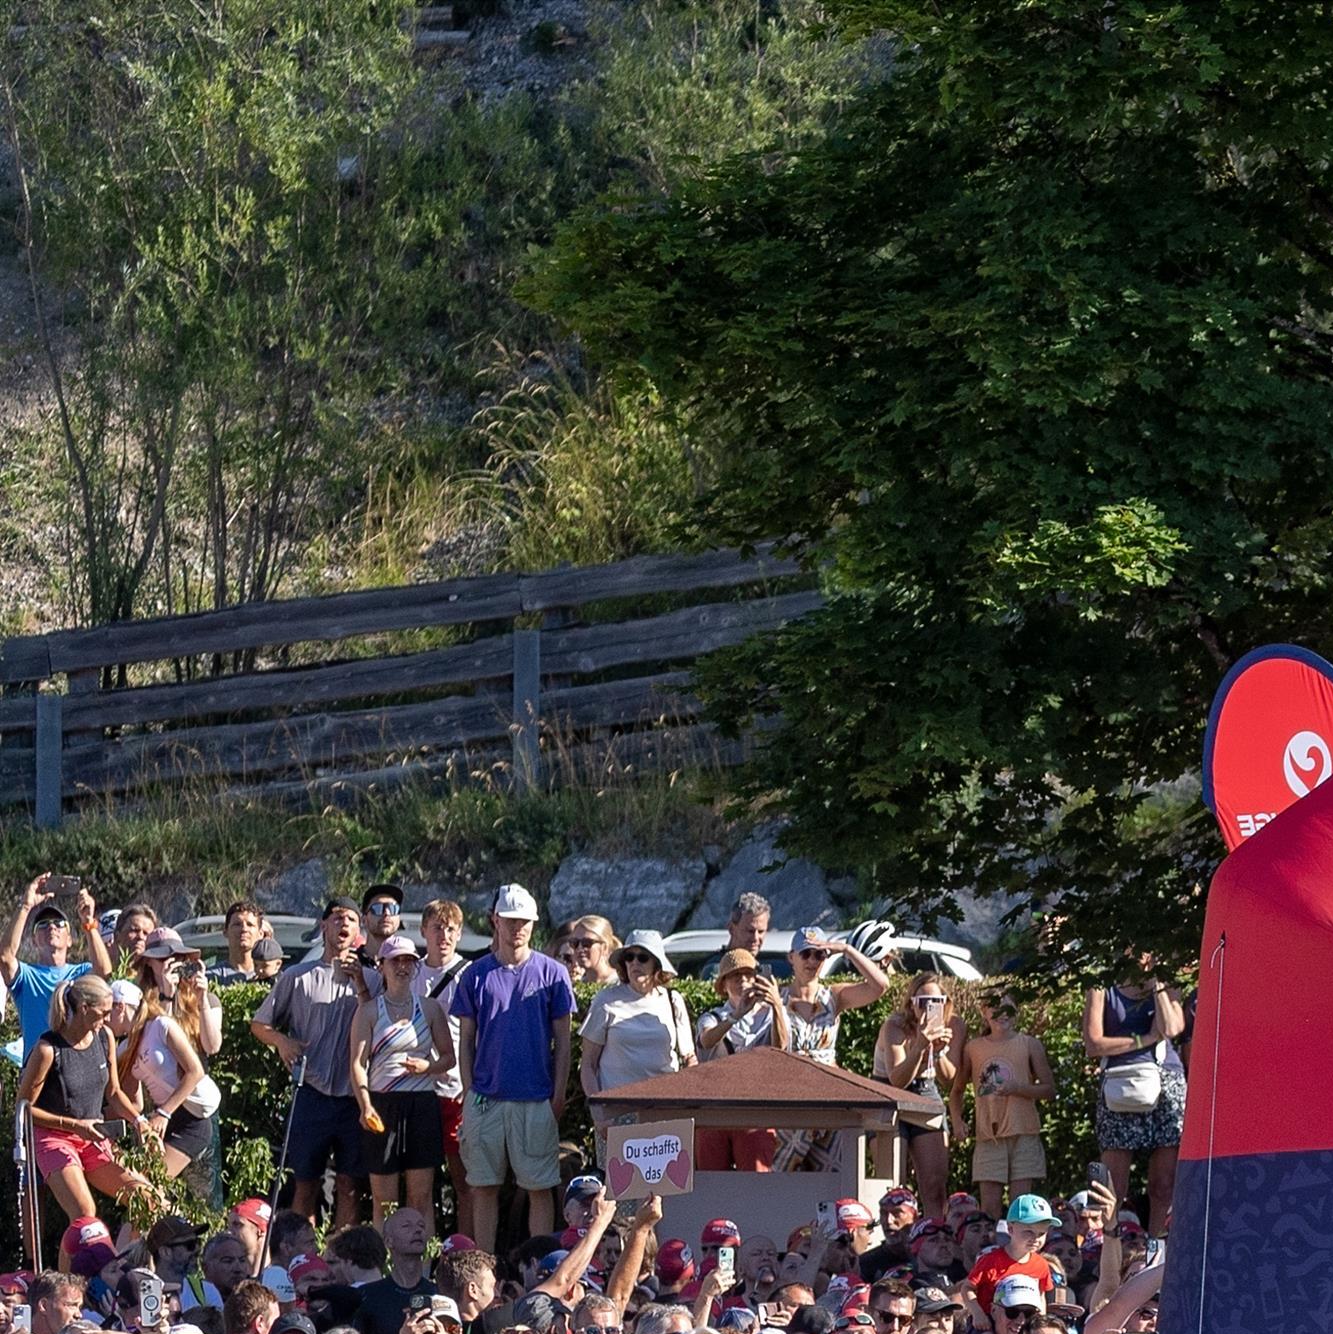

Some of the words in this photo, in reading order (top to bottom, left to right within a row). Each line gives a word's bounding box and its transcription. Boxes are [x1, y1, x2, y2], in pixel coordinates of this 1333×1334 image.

[626, 1145, 640, 1160] Du
[642, 1139, 679, 1158] schaffst
[645, 1166, 662, 1181] das
